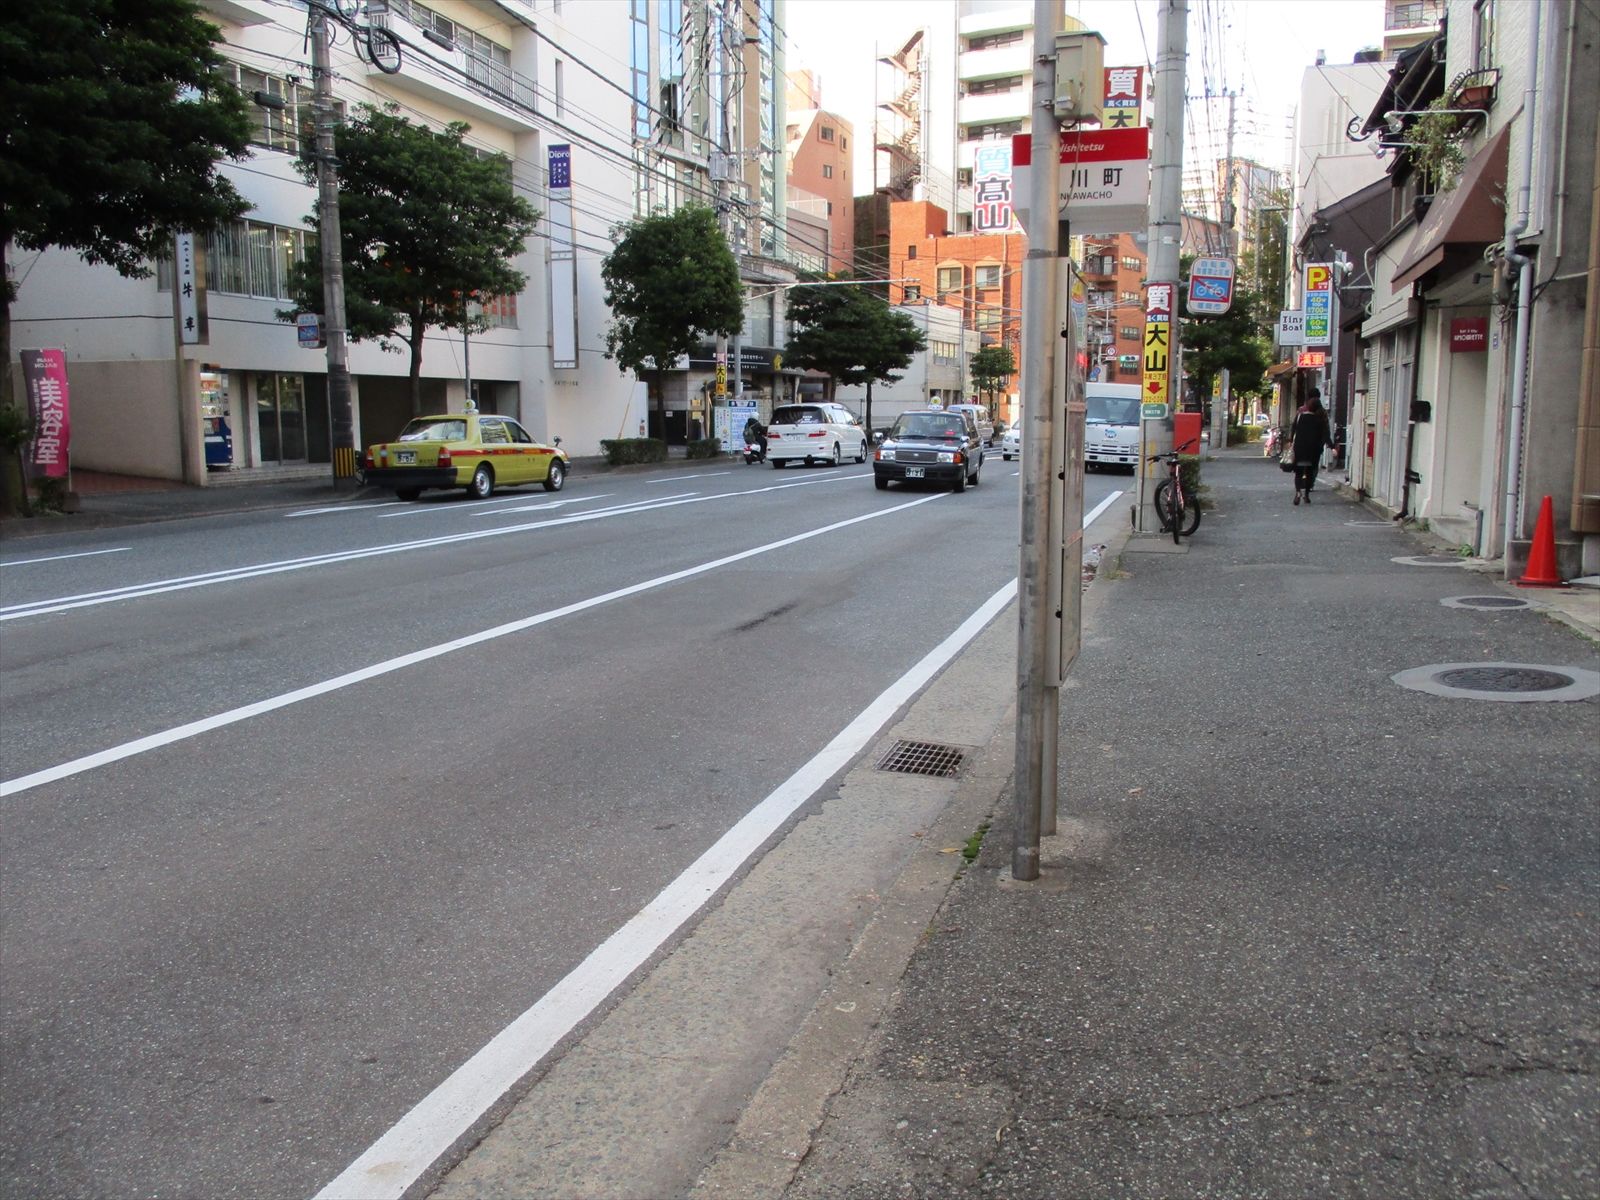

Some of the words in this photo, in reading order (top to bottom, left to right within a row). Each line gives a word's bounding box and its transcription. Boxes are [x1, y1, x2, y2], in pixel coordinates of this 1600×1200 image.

[1107, 69, 1138, 97] 質
[1309, 267, 1327, 290] P
[1147, 286, 1170, 312] 質
[1146, 324, 1167, 371] 大山
